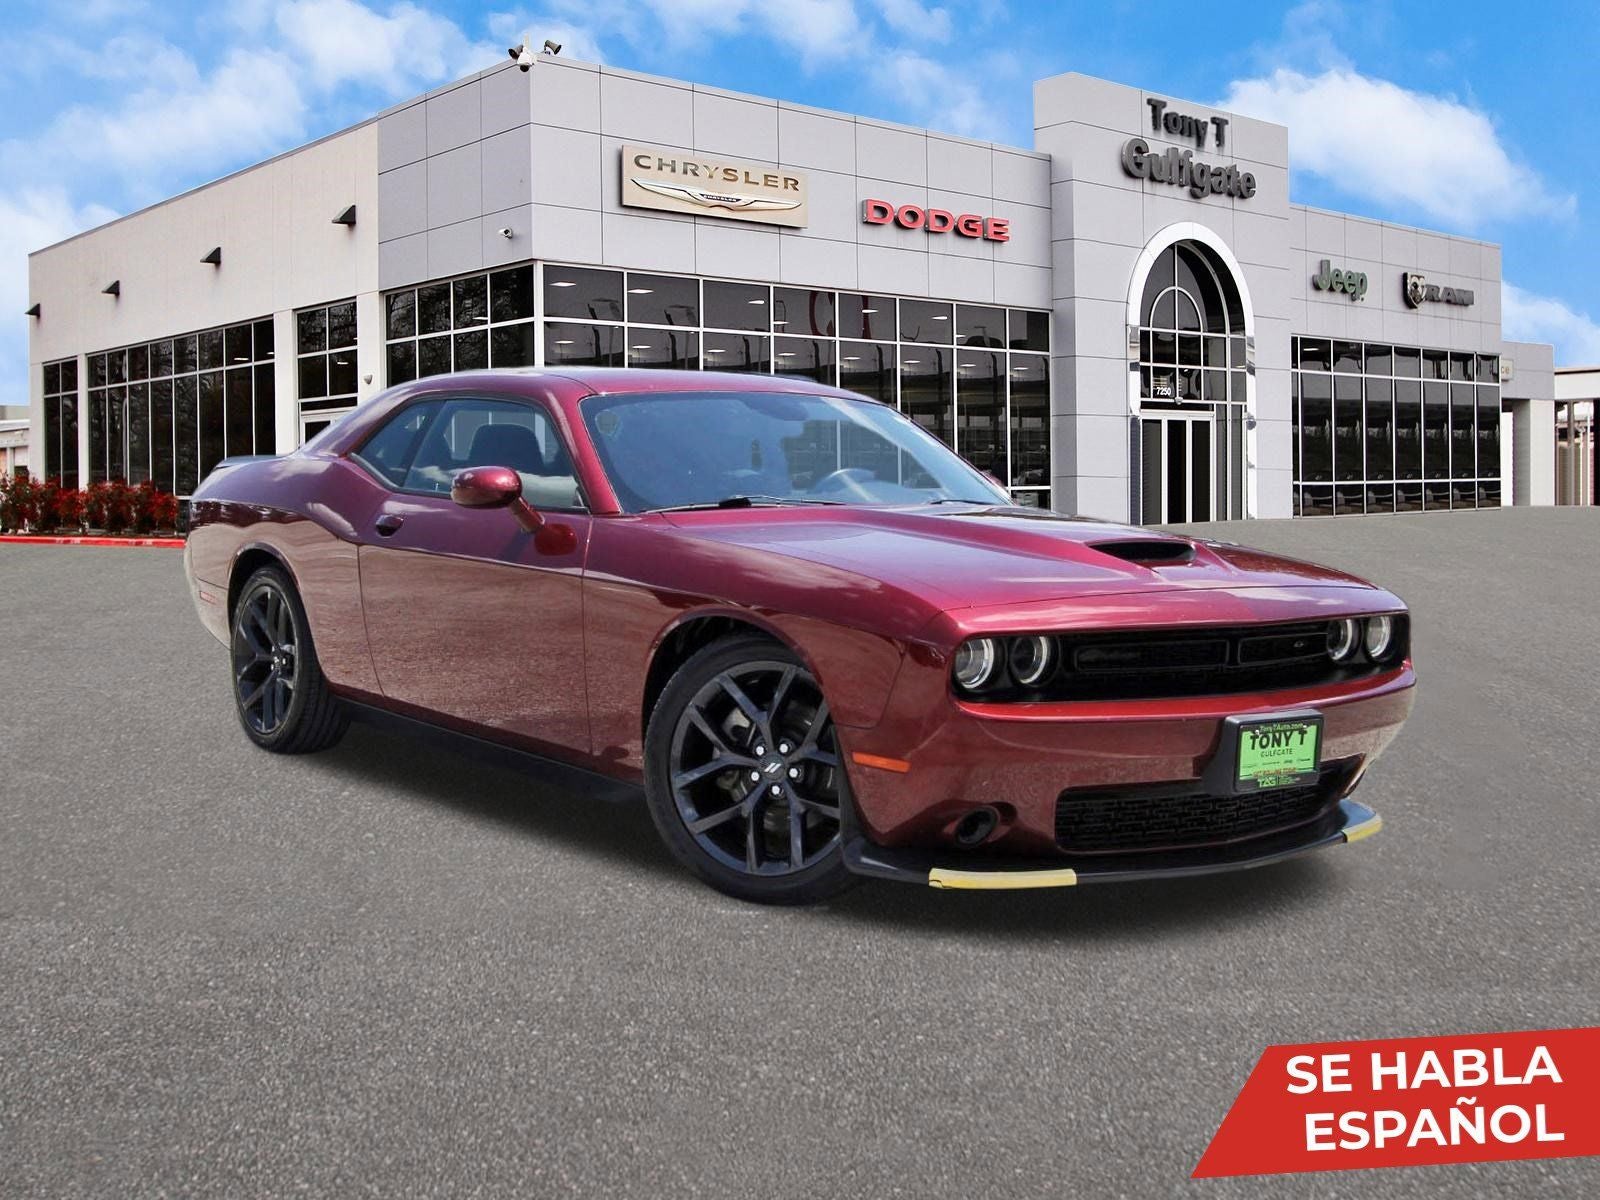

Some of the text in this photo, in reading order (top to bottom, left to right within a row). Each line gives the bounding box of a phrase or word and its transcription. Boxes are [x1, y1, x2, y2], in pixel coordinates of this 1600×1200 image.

[1146, 98, 1229, 148] Tony T
[634, 154, 800, 192] CHRYSLER
[1121, 138, 1257, 199] Gulfgate
[860, 199, 1010, 242] DODGE
[1311, 259, 1368, 302] Jeep
[1424, 283, 1475, 307] RAM
[1156, 386, 1172, 396] 7250
[1250, 729, 1307, 750] TONY T
